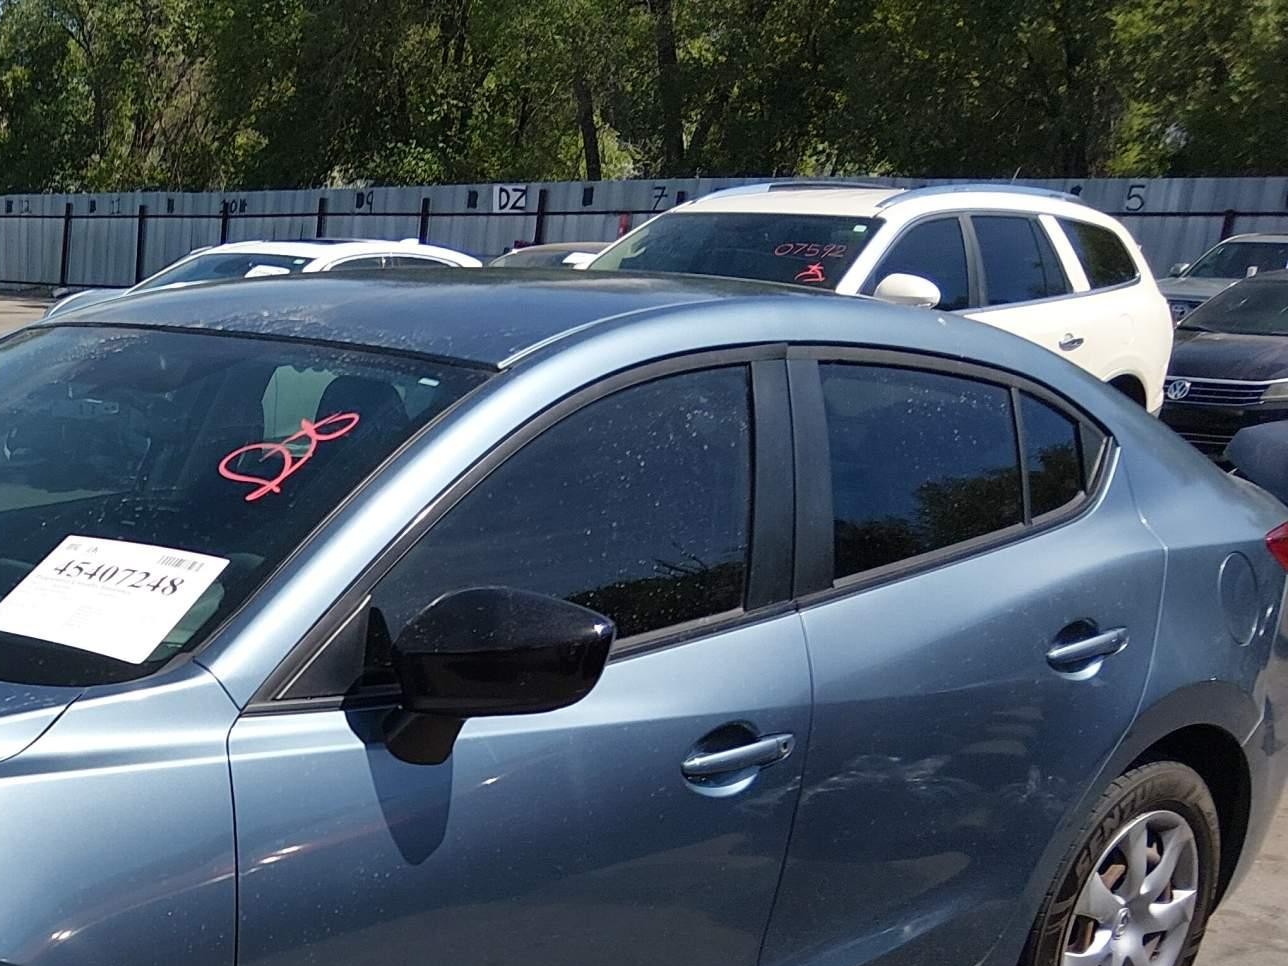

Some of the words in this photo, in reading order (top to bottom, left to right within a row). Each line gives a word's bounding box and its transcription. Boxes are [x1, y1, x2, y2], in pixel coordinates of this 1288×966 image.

[1125, 184, 1146, 212] 5
[774, 243, 847, 258] 07592
[53, 559, 185, 596] 45407248
